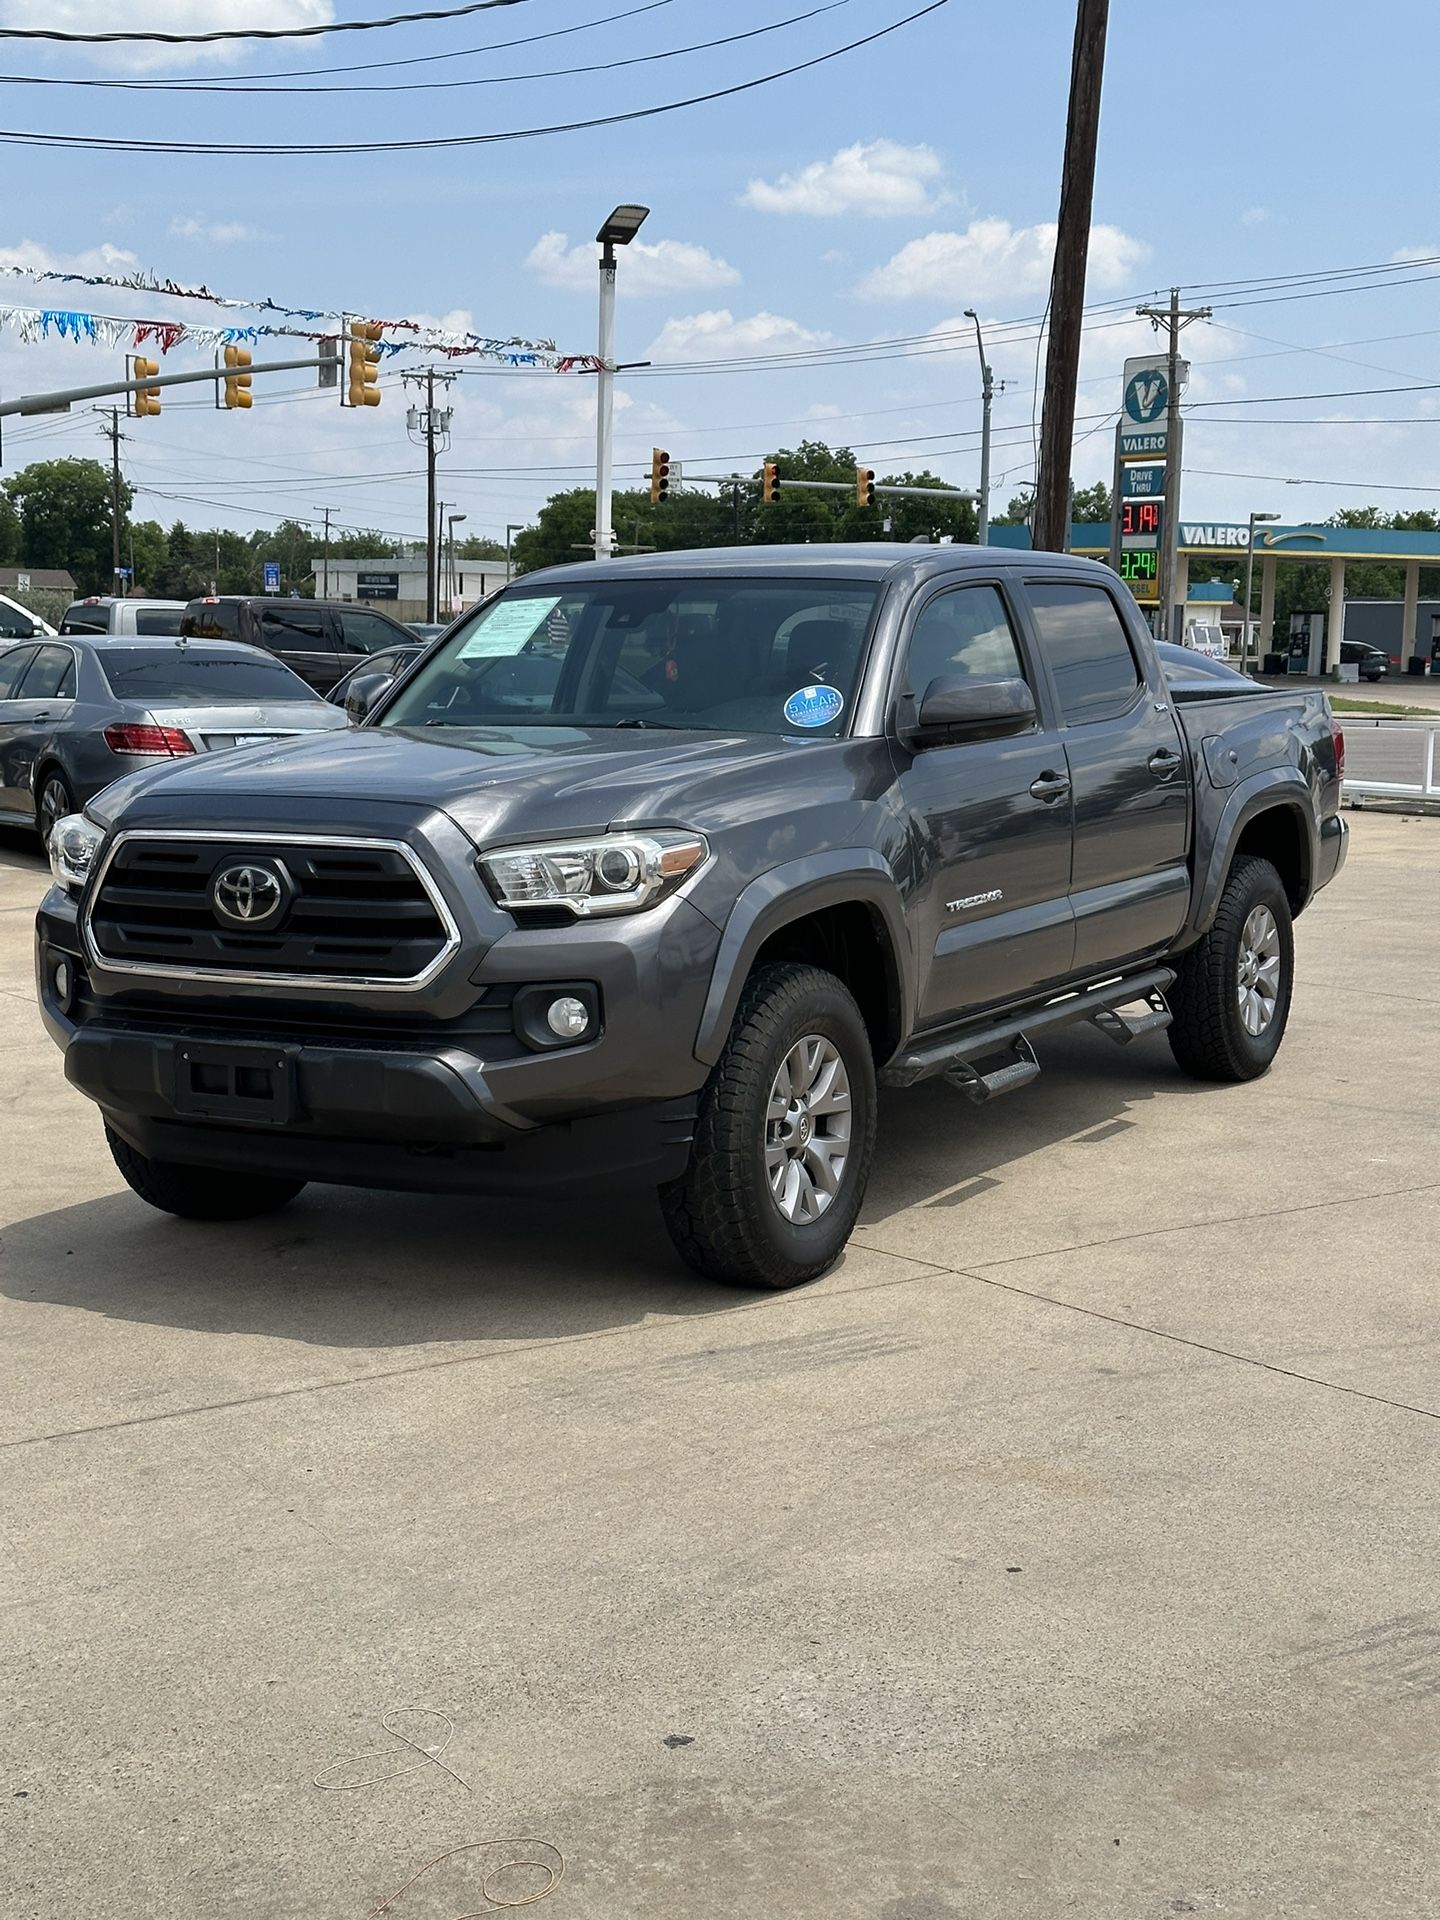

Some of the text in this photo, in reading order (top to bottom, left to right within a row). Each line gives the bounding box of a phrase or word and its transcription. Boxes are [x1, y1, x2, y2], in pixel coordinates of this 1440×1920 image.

[1123, 436, 1165, 451] VALERO
[1130, 469, 1153, 481] DRIVE
[1130, 481, 1152, 493] THRU
[1183, 526, 1250, 545] VALERO
[788, 693, 837, 714] 5 YEAR
